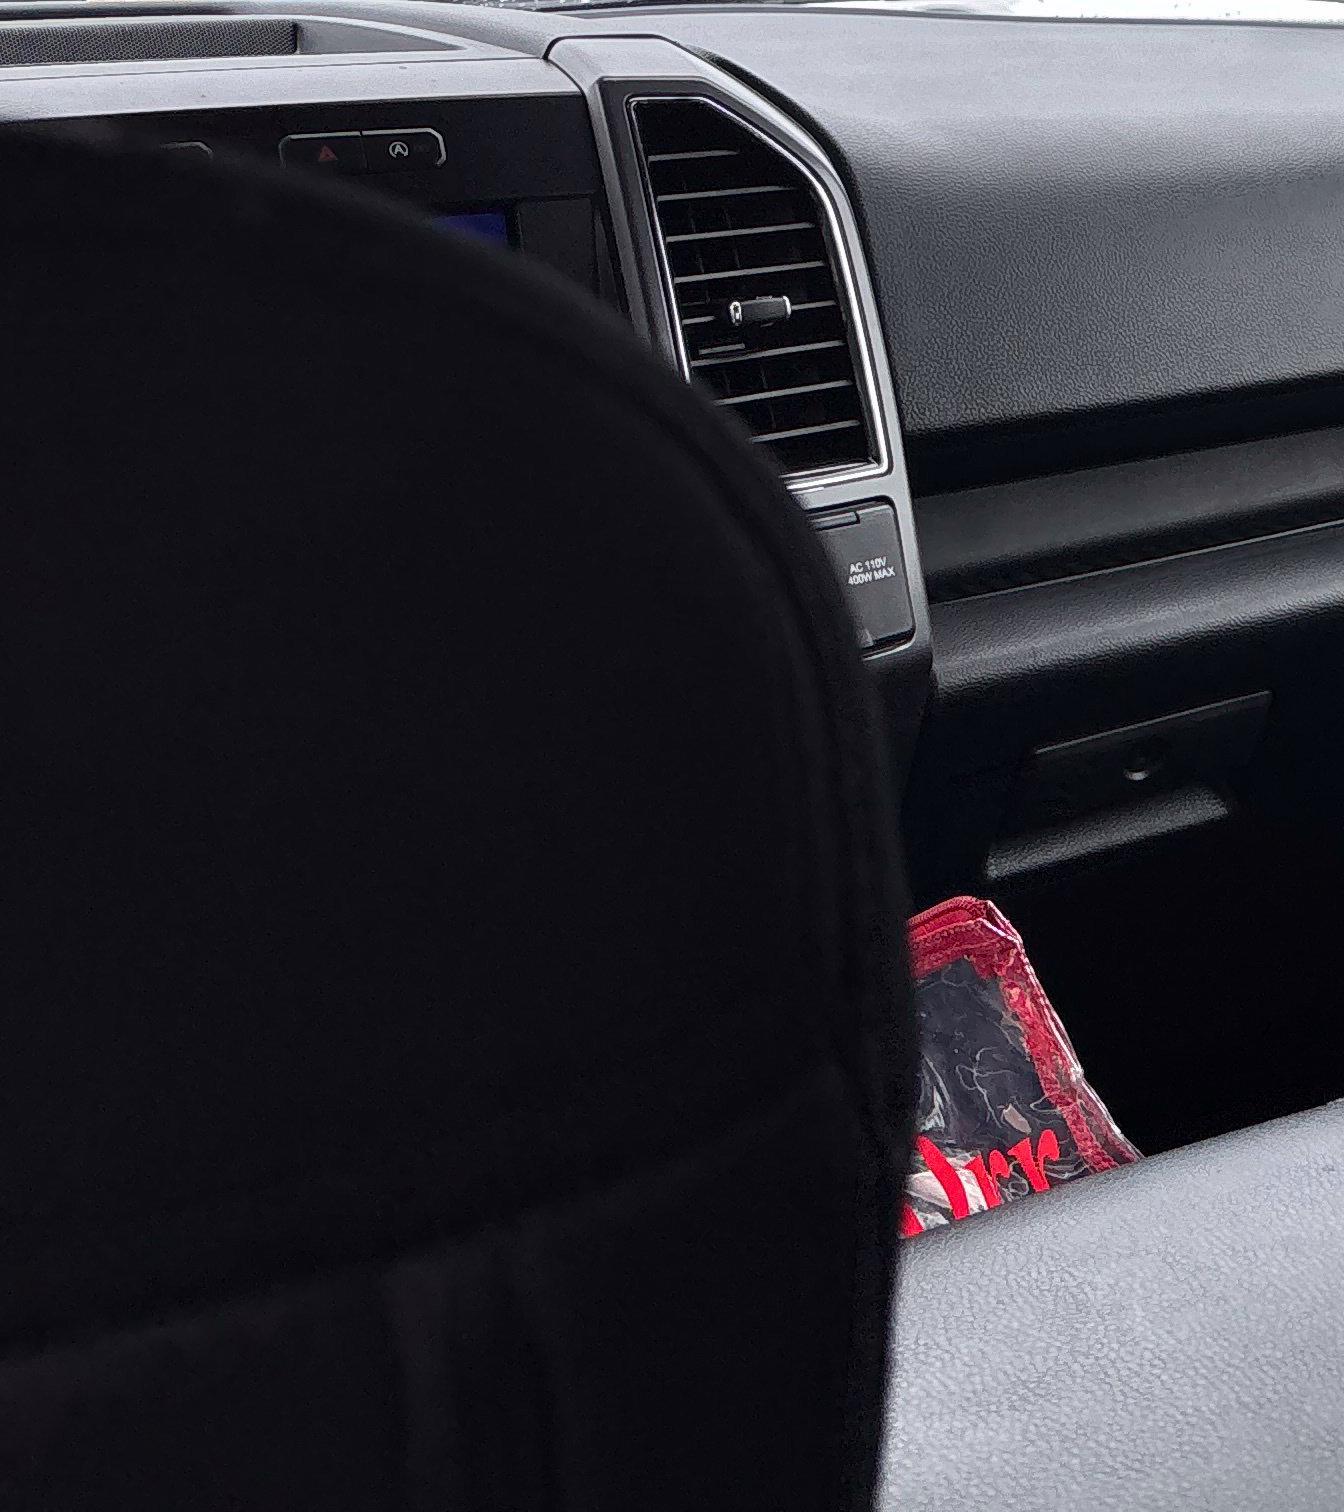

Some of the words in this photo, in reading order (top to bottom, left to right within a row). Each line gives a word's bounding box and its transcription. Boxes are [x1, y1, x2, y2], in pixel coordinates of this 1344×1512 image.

[850, 562, 863, 574] AC
[865, 556, 887, 570] 110V
[848, 571, 873, 585] 400W
[873, 566, 896, 580] MAX
